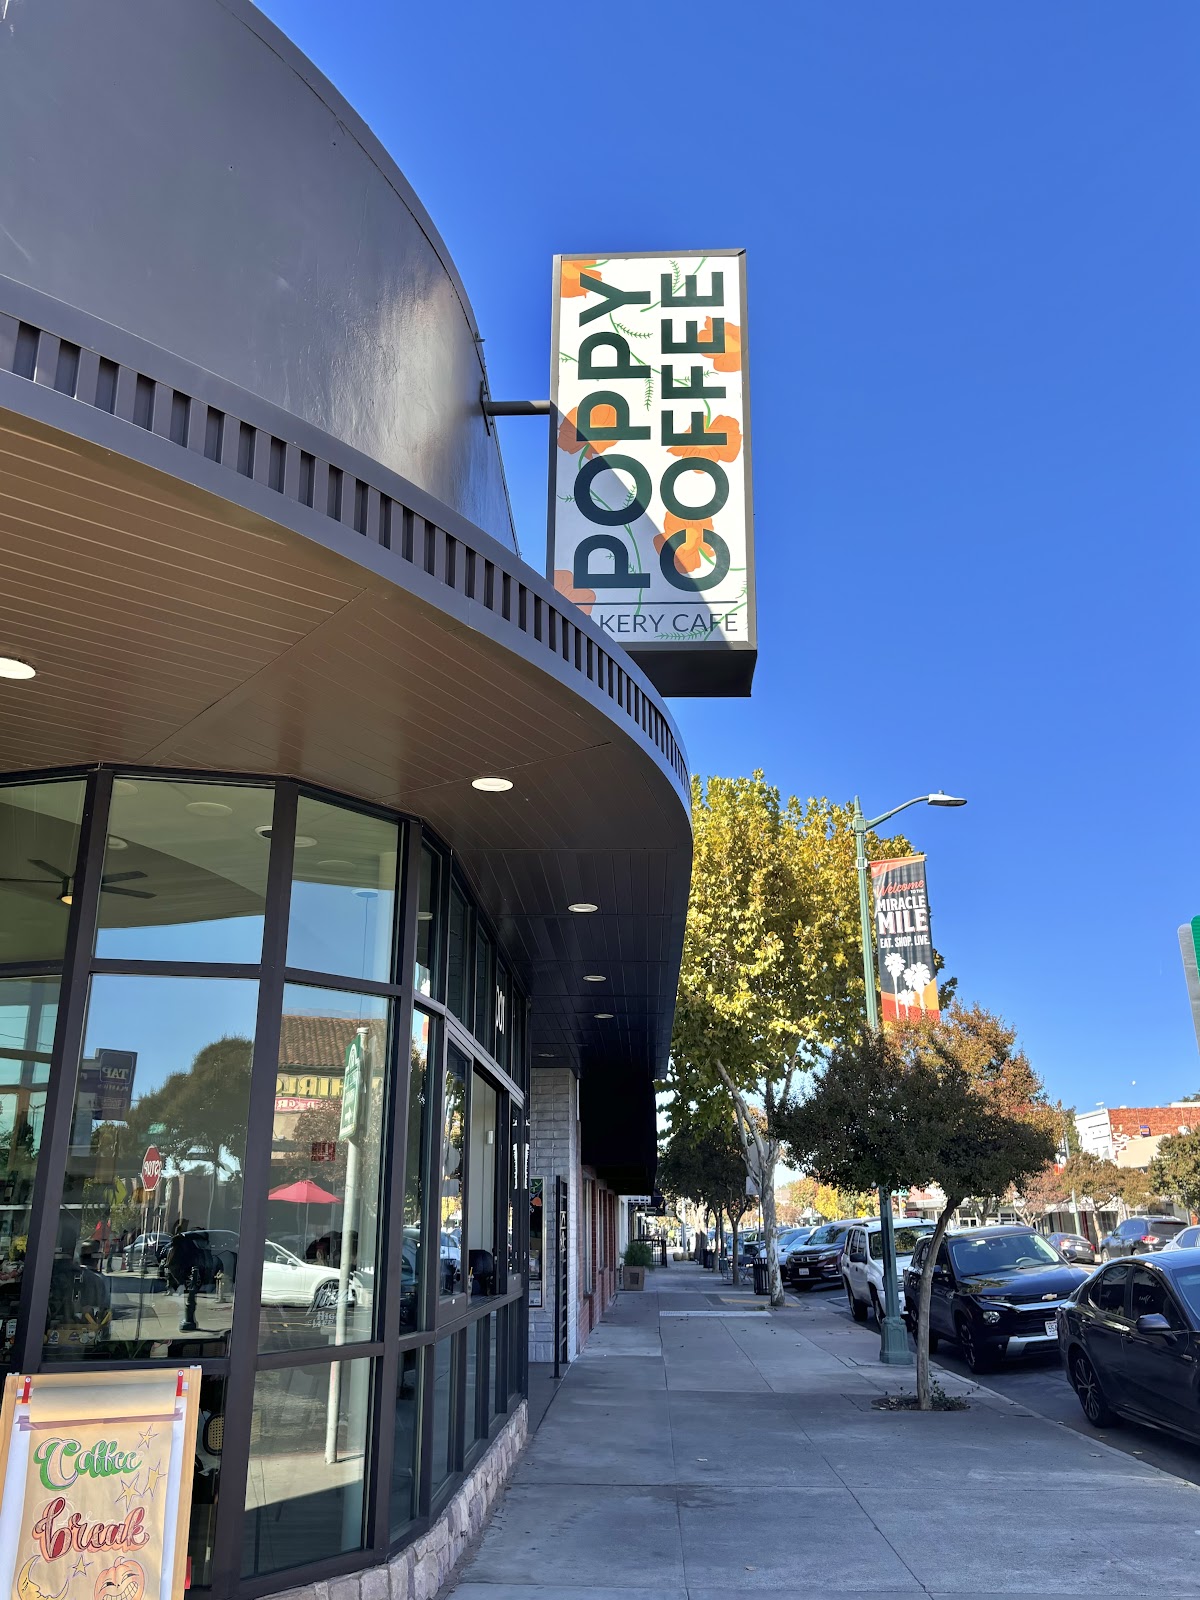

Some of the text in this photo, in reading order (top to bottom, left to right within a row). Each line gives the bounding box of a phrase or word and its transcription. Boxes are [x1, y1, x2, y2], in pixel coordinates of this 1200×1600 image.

[573, 271, 652, 590] POPPY
[660, 271, 730, 592] COFFEE
[600, 613, 738, 633] KERY CAFE
[875, 880, 924, 897] Welcome
[877, 895, 926, 911] MIRACLE
[879, 909, 928, 935] MILE
[880, 935, 930, 948] EAT. SHOP. LIVE.
[34, 1437, 142, 1491] Coffee
[32, 1497, 151, 1563] break
